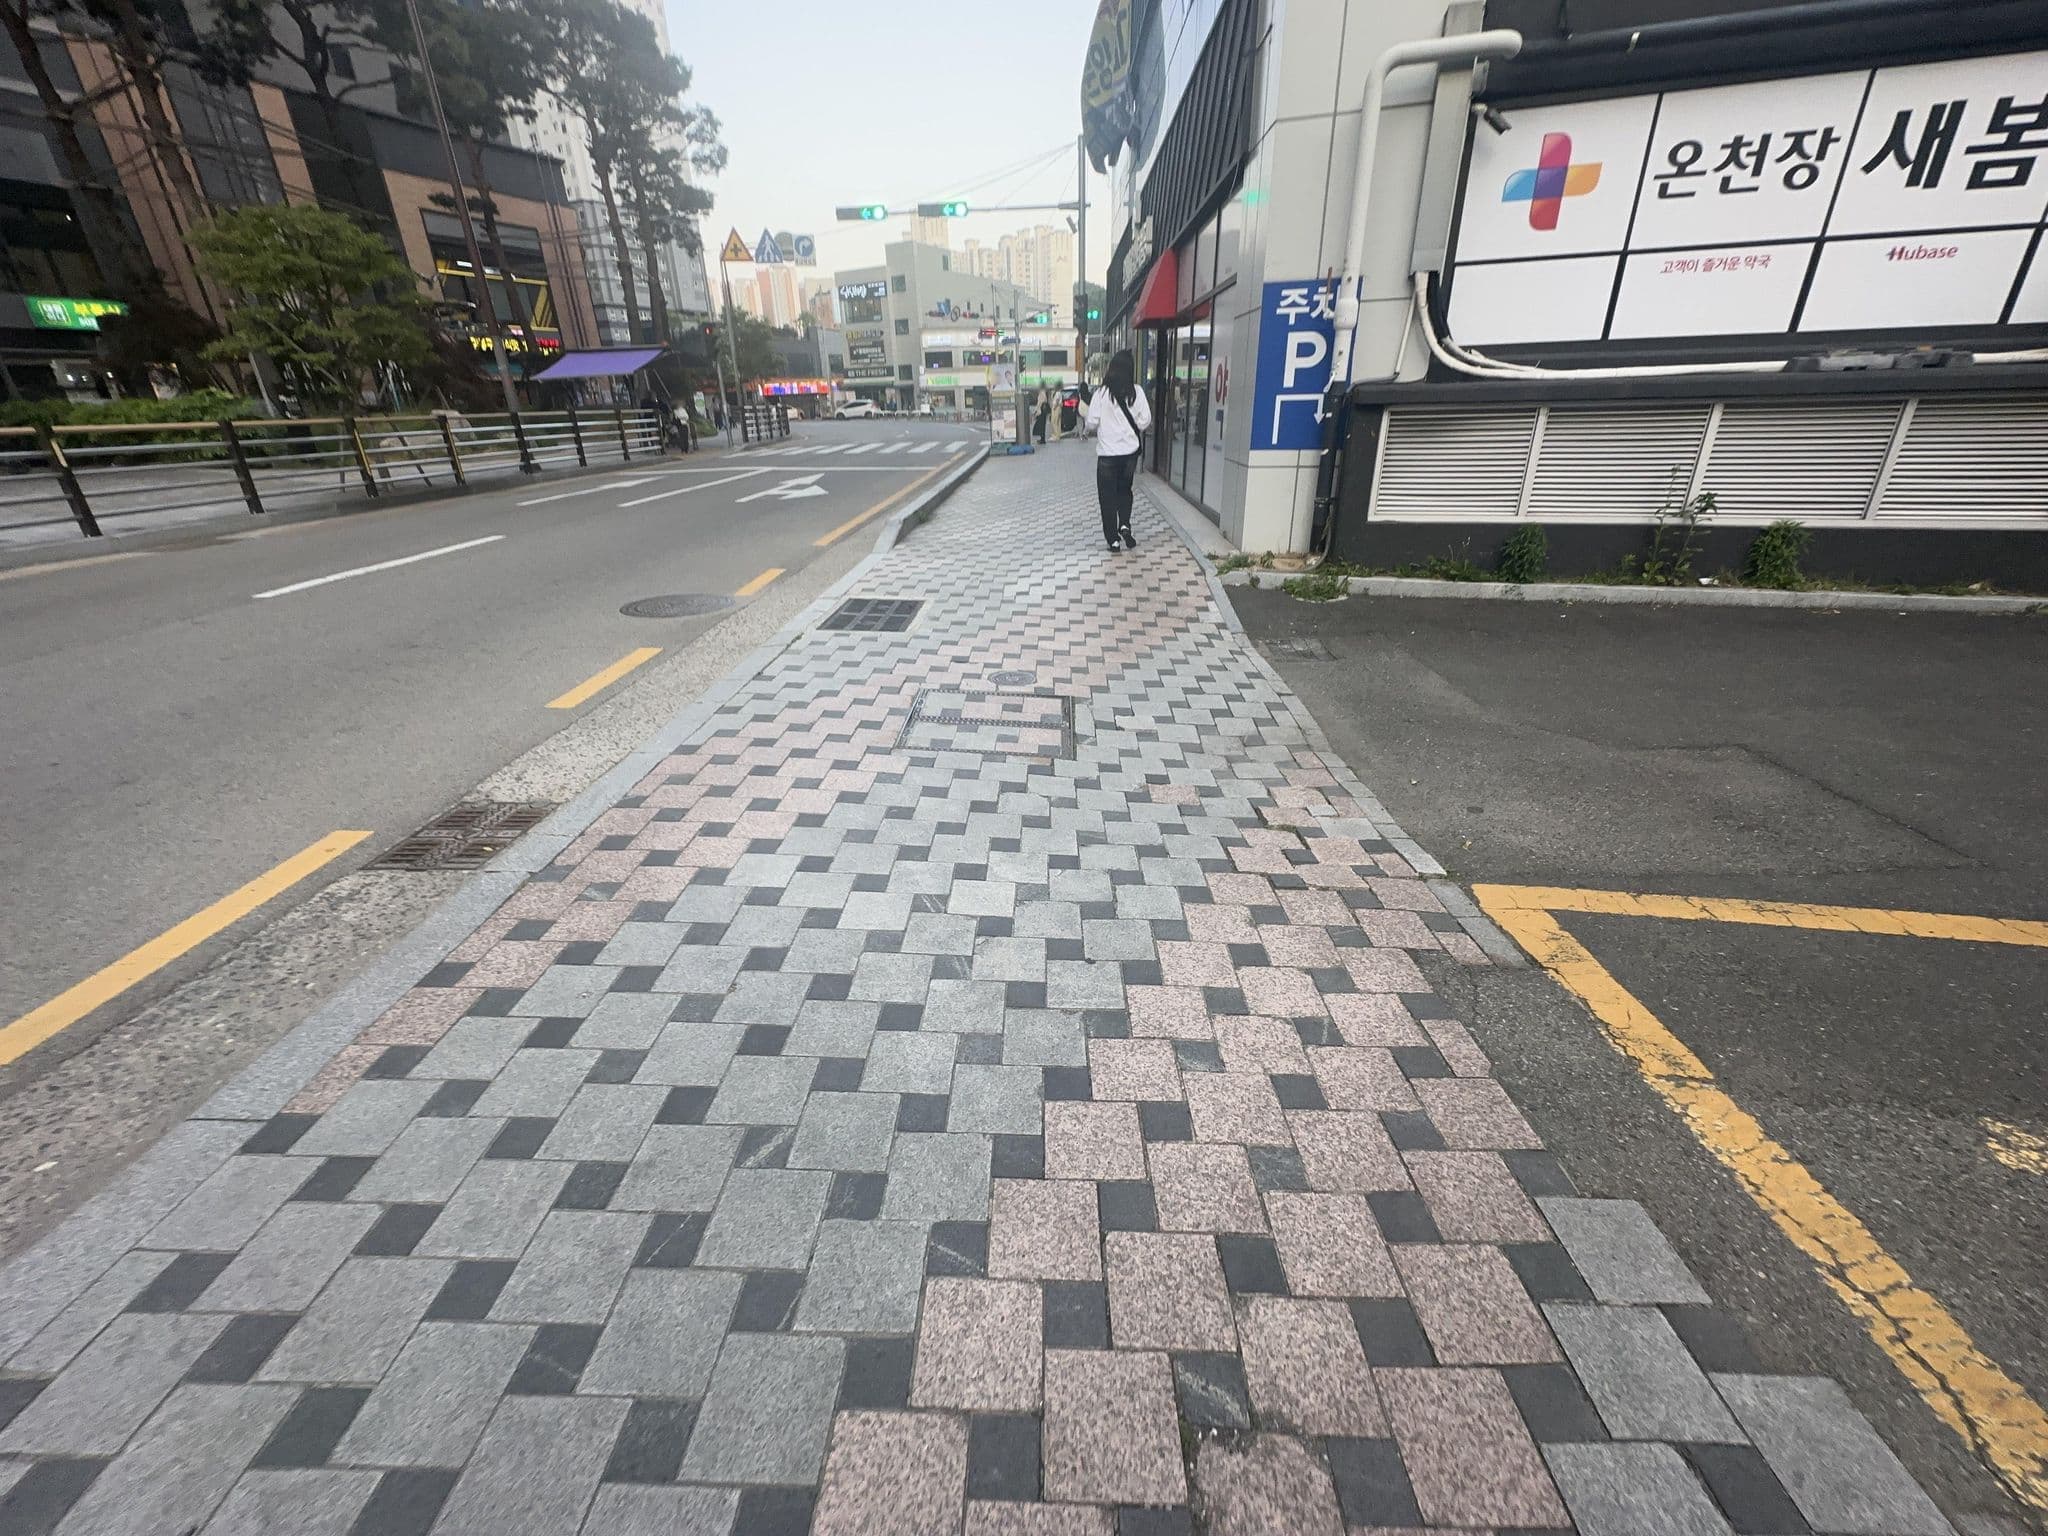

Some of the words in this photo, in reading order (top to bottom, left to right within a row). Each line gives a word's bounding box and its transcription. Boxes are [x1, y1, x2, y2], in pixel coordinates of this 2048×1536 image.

[1653, 127, 1841, 199] 온천장
[1861, 94, 2048, 190] 새봄
[1660, 259, 1700, 273] 고객이
[1702, 256, 1741, 272] 즐거운
[1744, 255, 1772, 270] 약국
[1886, 245, 1958, 261] Hubase
[1283, 331, 1327, 388] P
